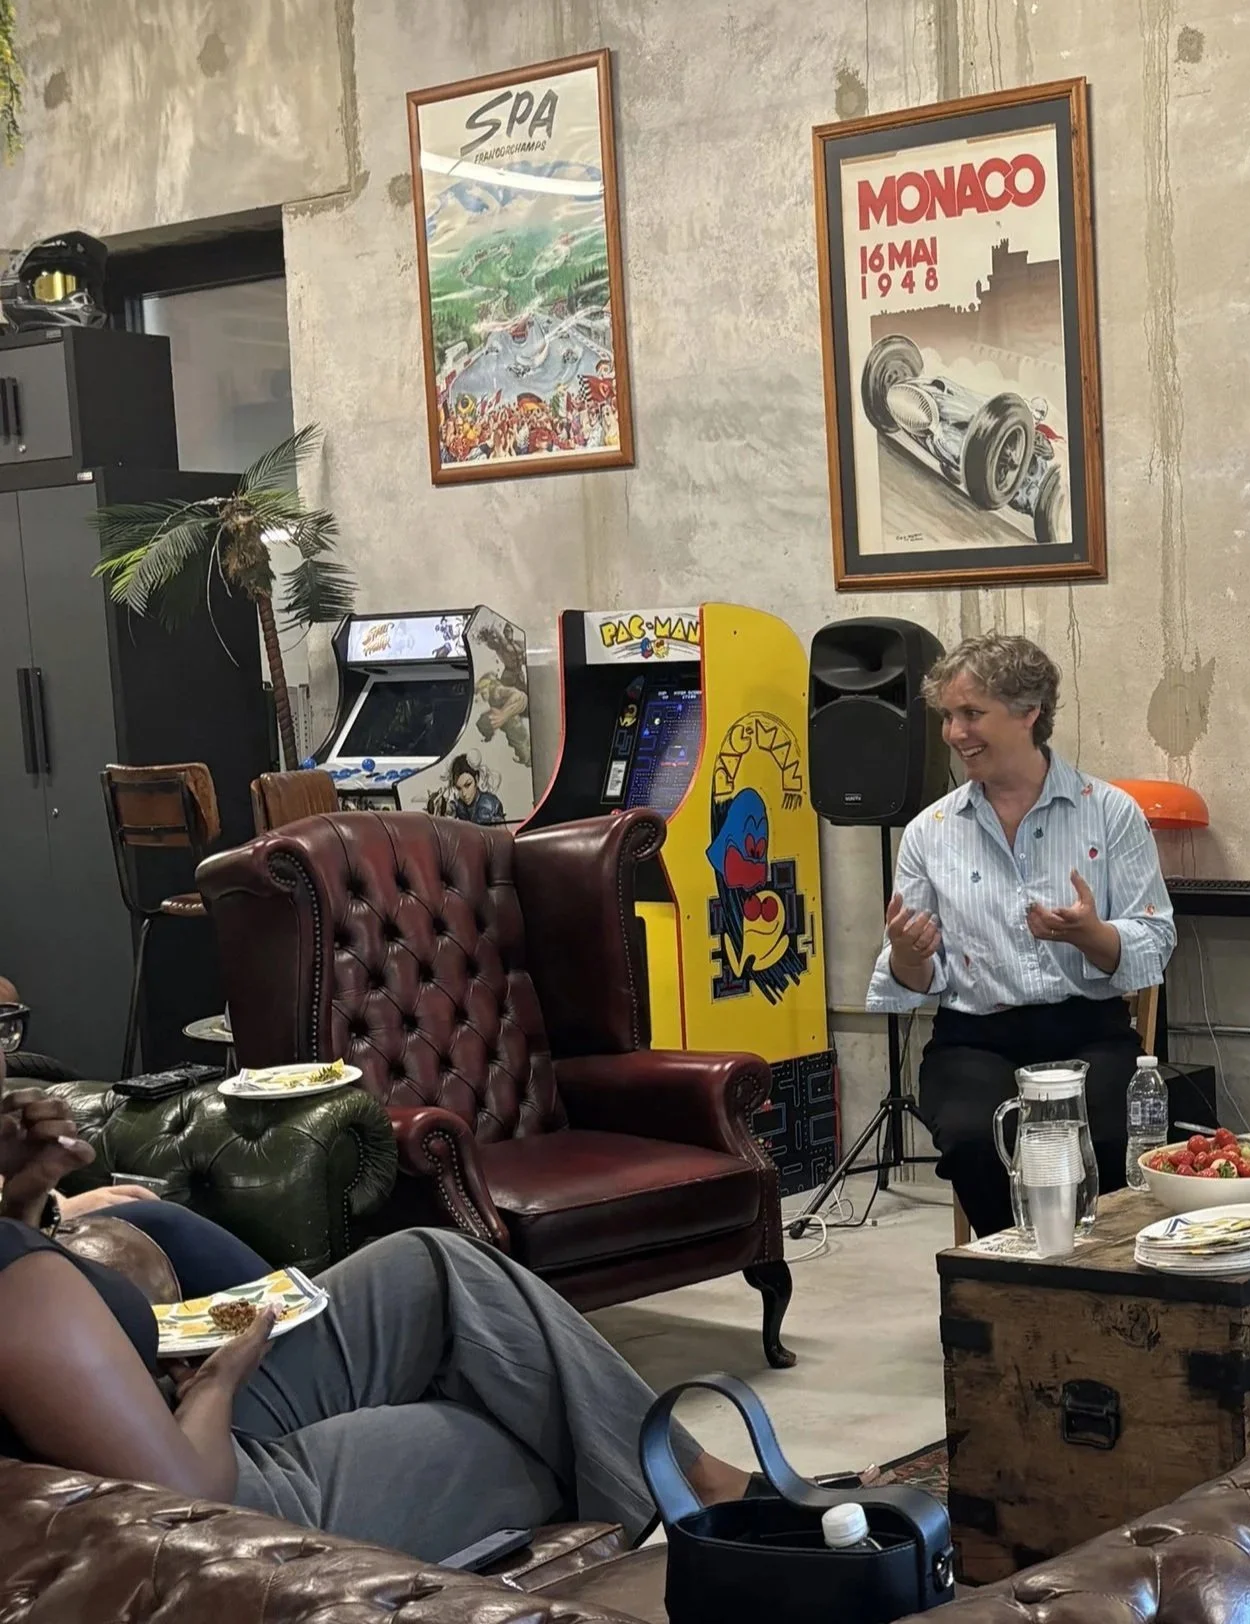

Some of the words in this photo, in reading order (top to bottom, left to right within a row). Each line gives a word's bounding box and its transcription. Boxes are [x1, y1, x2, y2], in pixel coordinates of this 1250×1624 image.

[460, 88, 559, 158] SPA
[857, 153, 1046, 231] MONACO
[860, 243, 885, 275] 16
[888, 236, 938, 271] MAI
[861, 266, 939, 300] 1948
